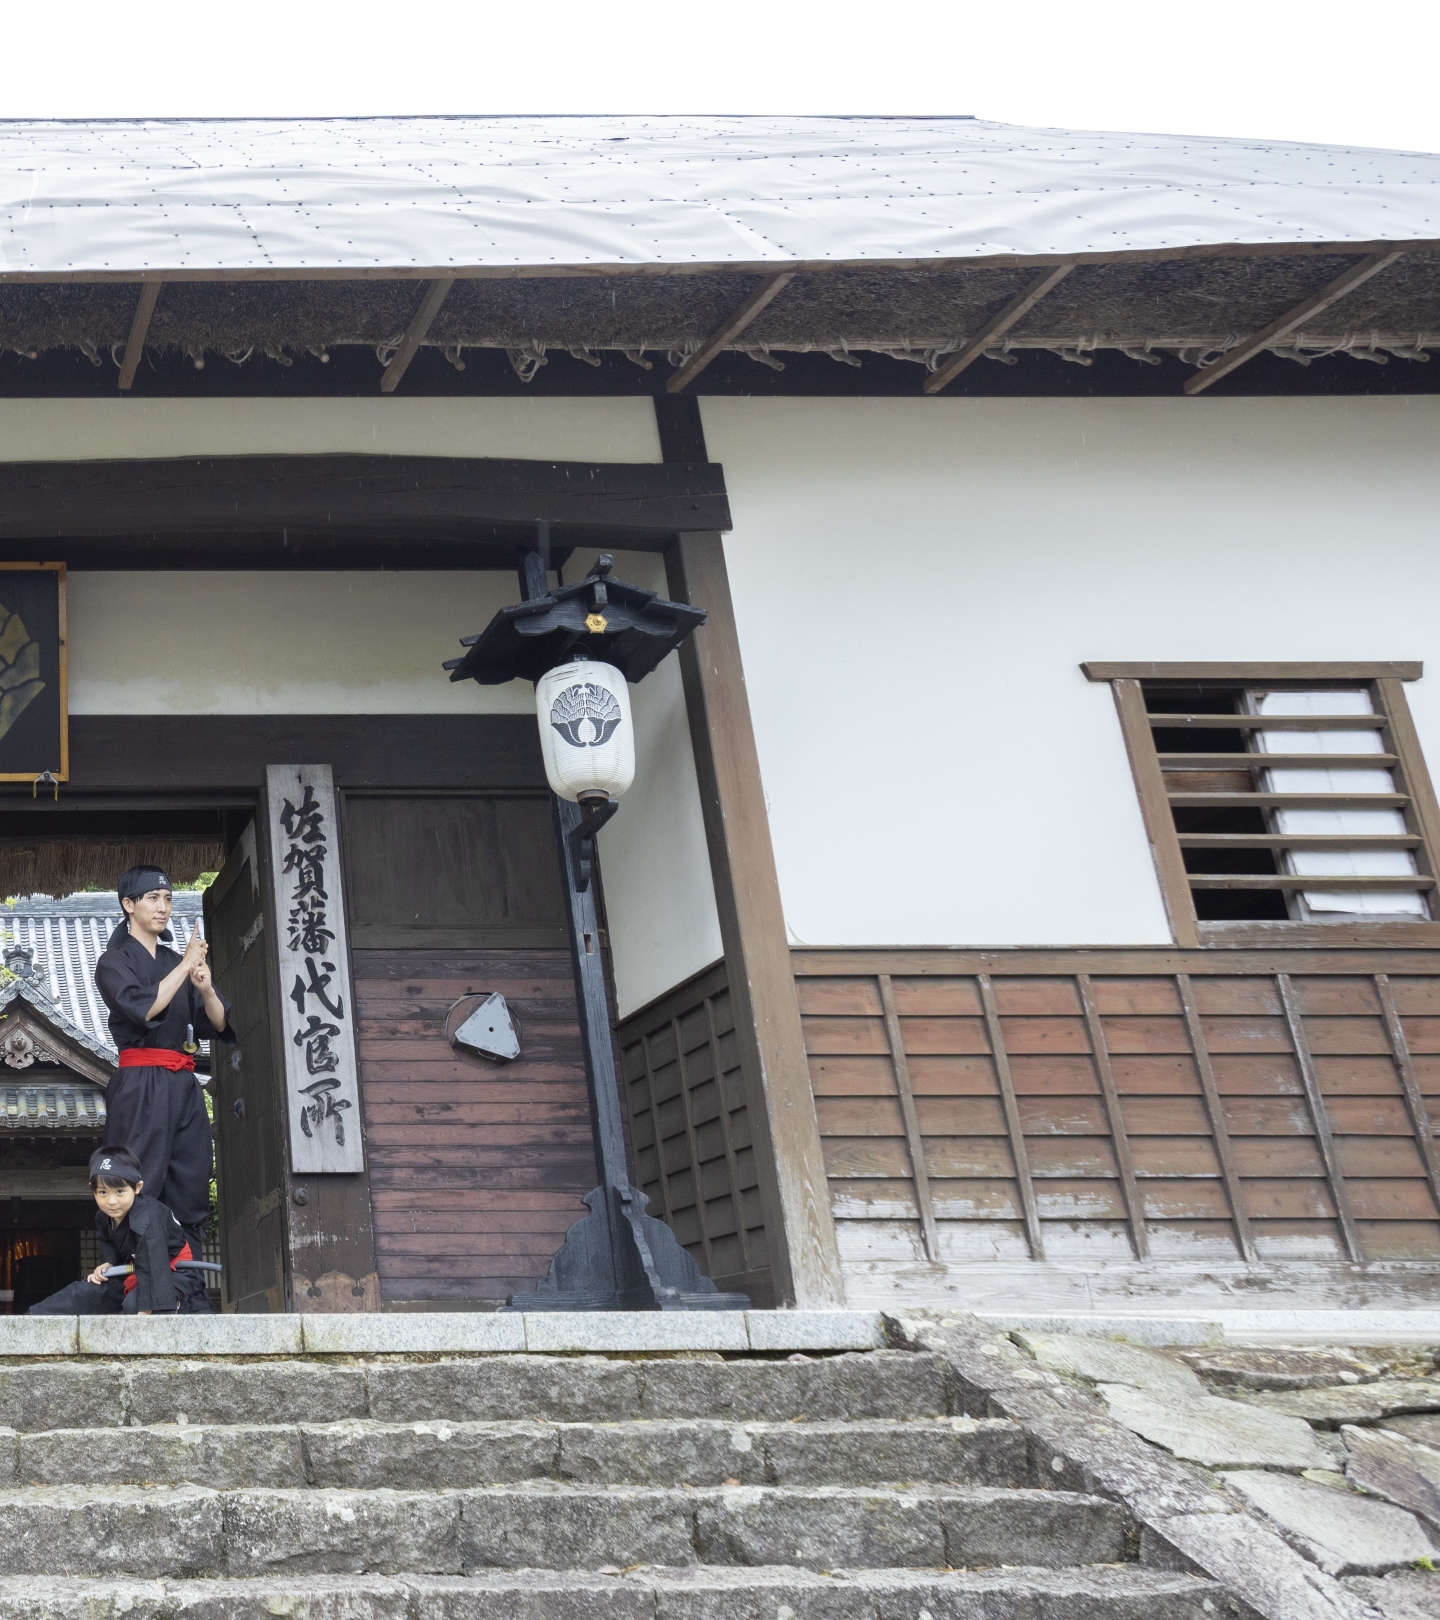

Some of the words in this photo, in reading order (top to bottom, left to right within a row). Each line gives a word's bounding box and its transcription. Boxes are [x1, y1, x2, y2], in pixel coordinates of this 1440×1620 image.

[279, 786, 351, 1146] 佐賀藩代官所
[99, 1158, 112, 1170] 忍
